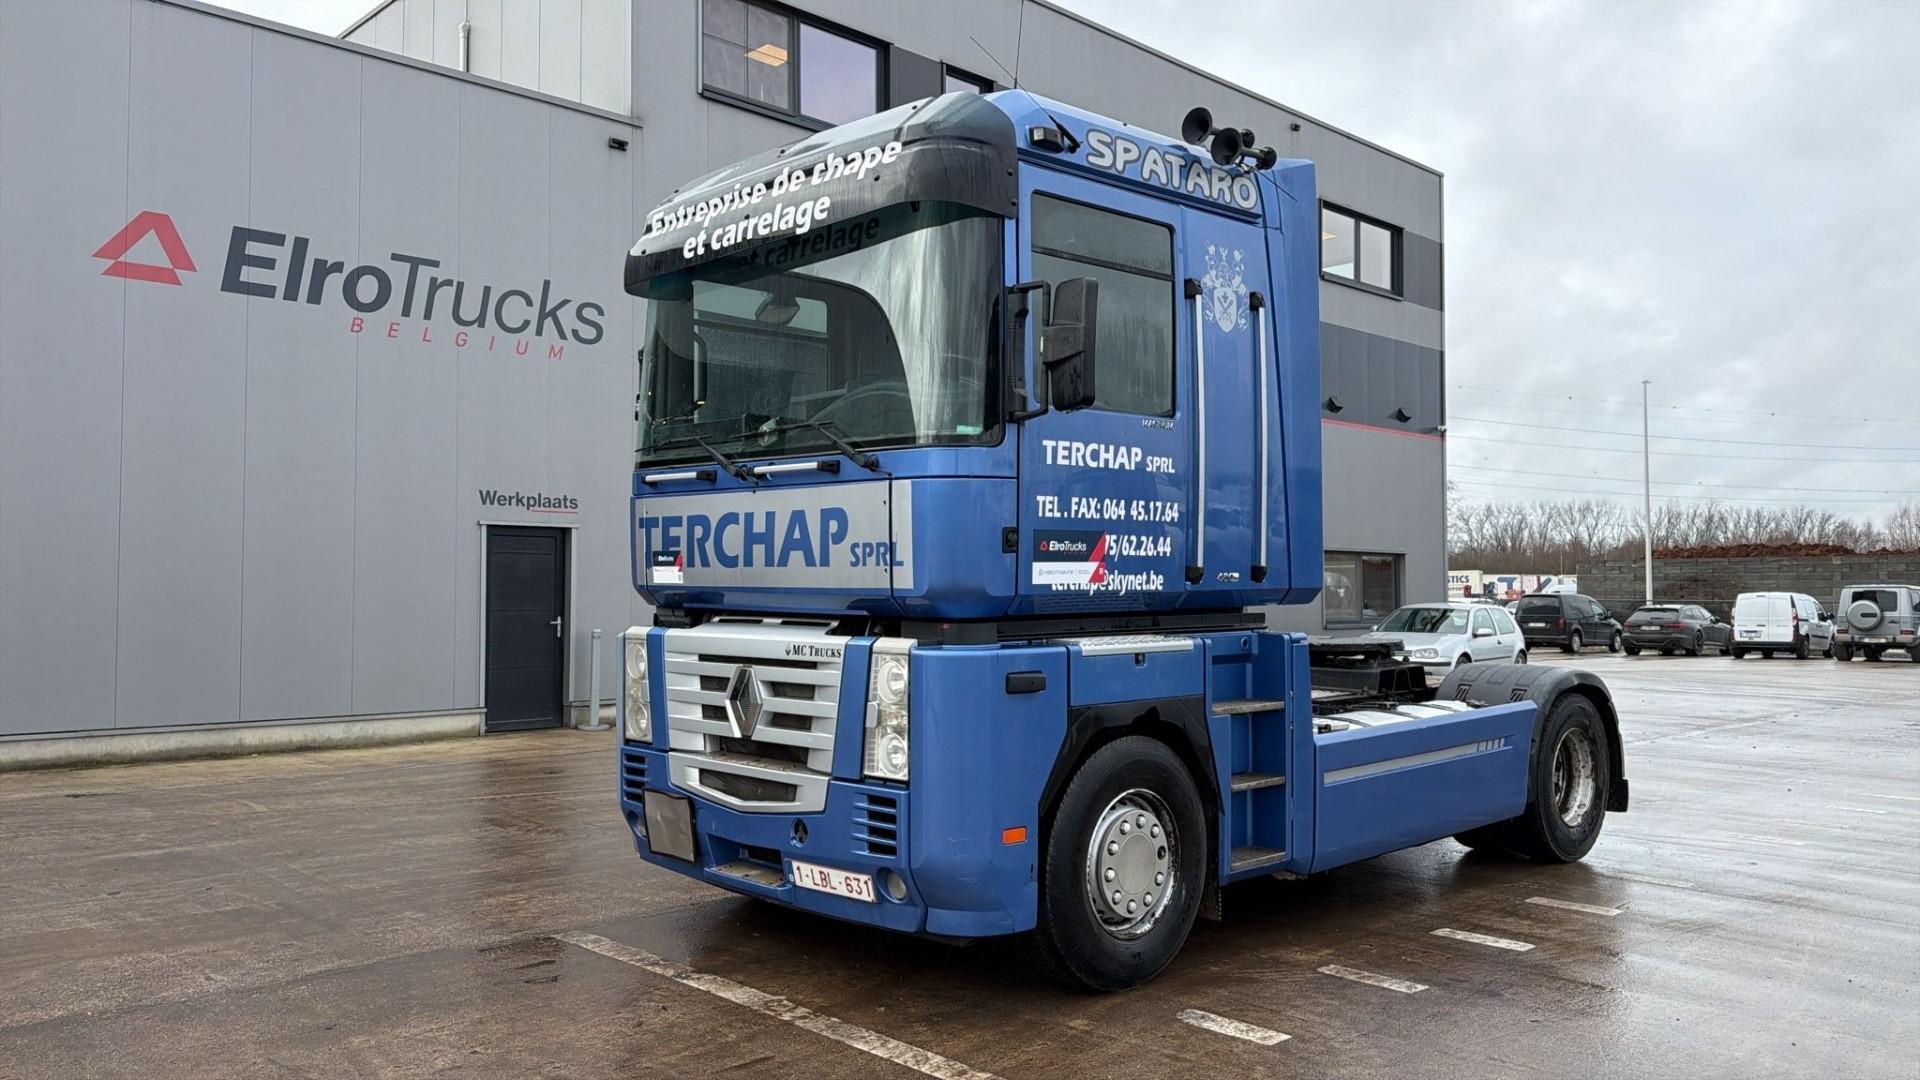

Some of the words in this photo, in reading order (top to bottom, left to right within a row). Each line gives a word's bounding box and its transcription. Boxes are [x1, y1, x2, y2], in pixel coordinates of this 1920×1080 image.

[648, 181, 767, 239] Entreprise
[772, 167, 806, 197] de
[811, 140, 902, 187] chape
[1085, 129, 1259, 209] SPATARO
[683, 232, 706, 259] et
[711, 195, 831, 249] carrelage
[220, 226, 605, 345] ElroTrucks
[350, 316, 565, 360] BELGIUM
[1042, 440, 1142, 470] TERCHAP
[1146, 456, 1175, 473] SPRL
[479, 489, 579, 510] Werkplaats
[1071, 498, 1100, 519] FAX:
[1103, 500, 1125, 519] 064
[1130, 501, 1179, 522] 45.17.64
[638, 506, 849, 569] TERCHAP
[850, 542, 904, 567] SPRL
[1049, 540, 1087, 551] ElroTrucks
[792, 644, 807, 656] MC
